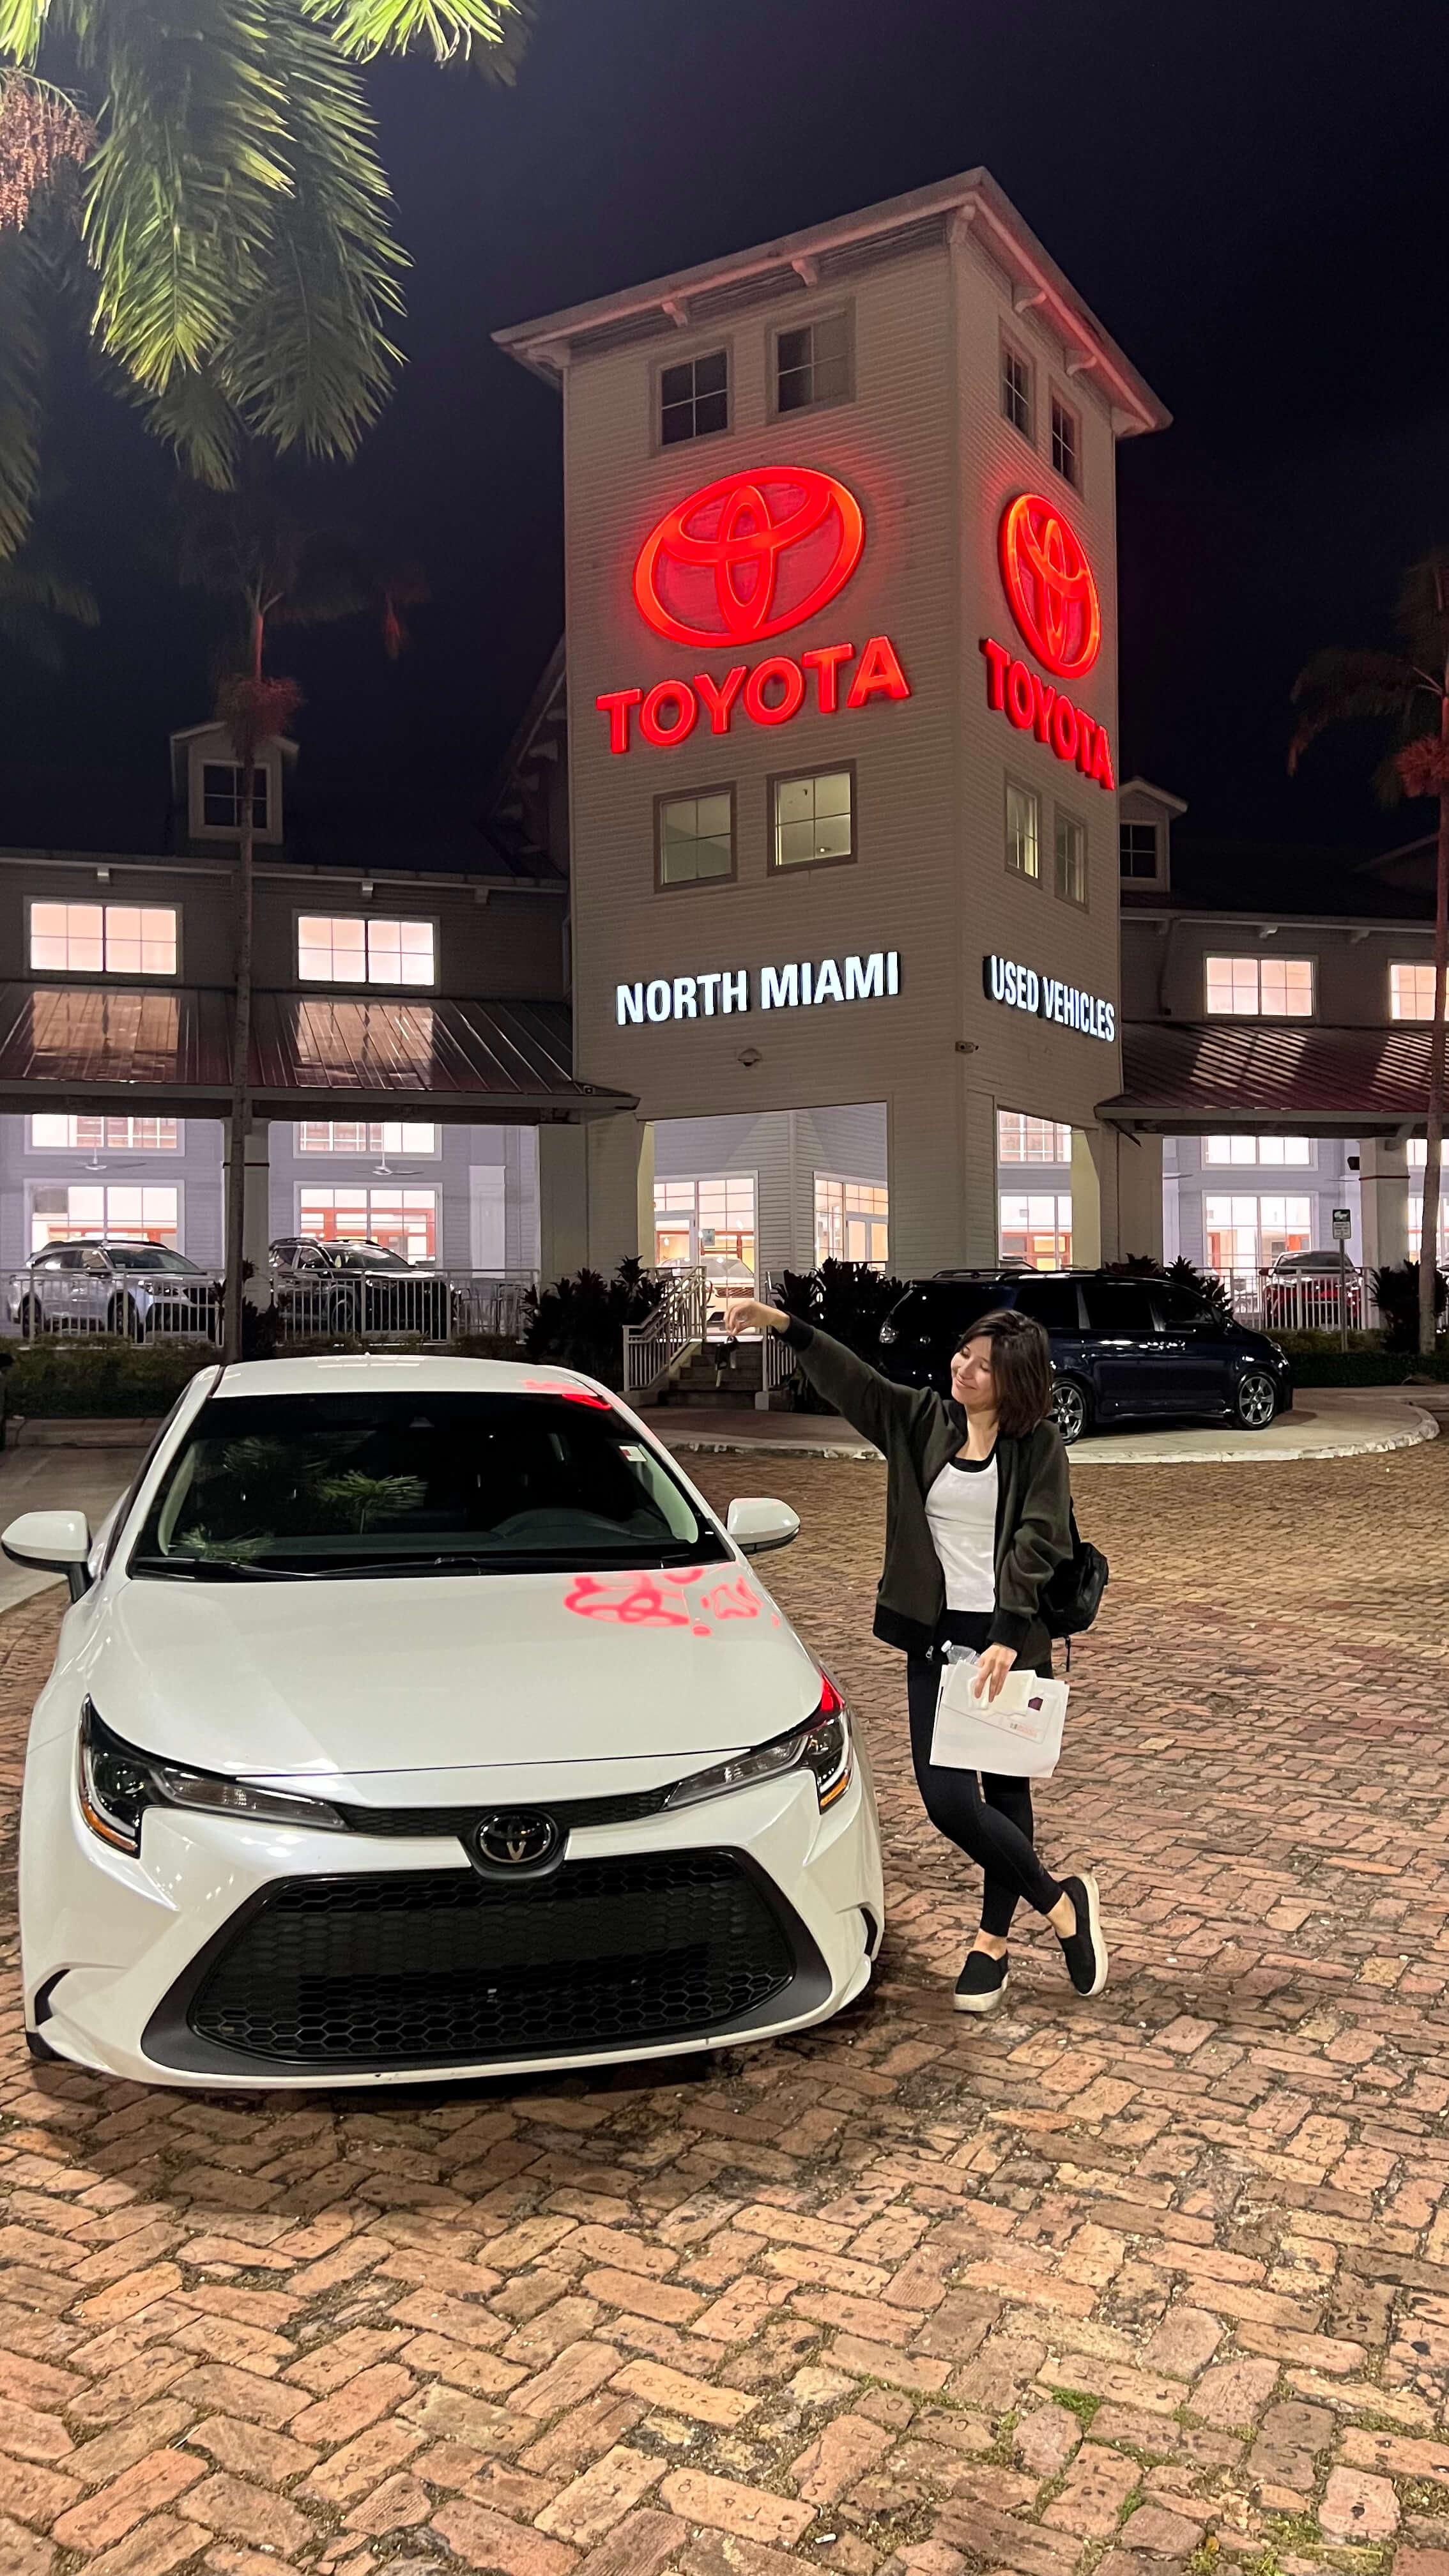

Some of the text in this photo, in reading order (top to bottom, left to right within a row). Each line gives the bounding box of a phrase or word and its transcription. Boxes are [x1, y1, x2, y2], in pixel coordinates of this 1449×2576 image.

[596, 635, 911, 753] TOYOTA
[981, 637, 1116, 791] TOYOTA
[616, 951, 900, 1026] NORTH MIAMI
[988, 954, 1116, 1043] USED VEHICLES
